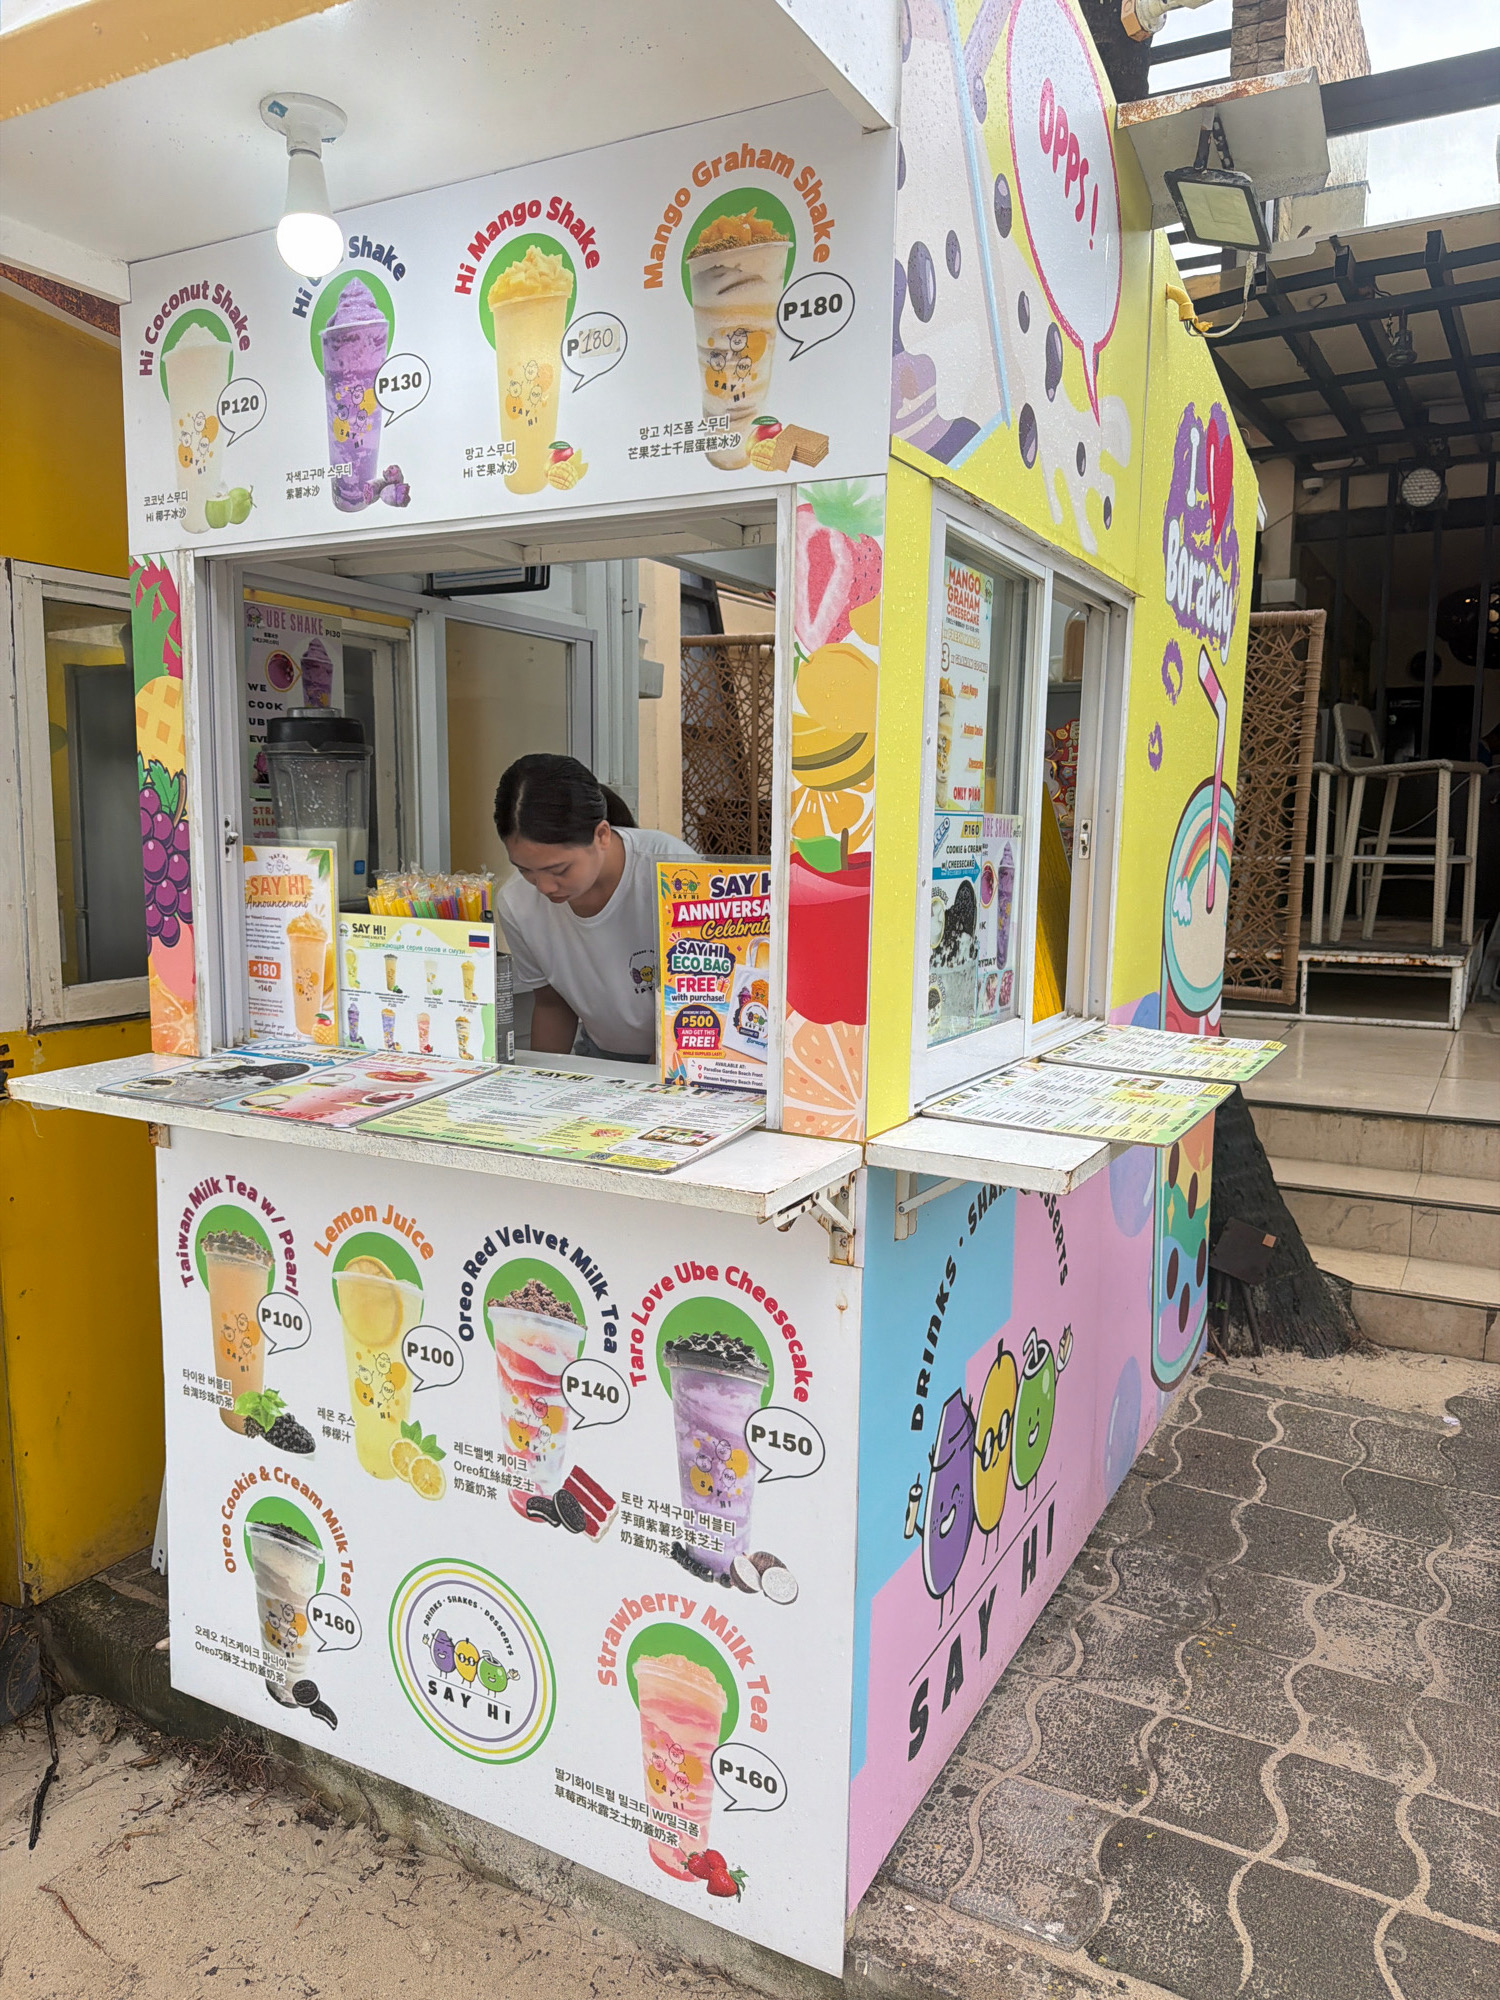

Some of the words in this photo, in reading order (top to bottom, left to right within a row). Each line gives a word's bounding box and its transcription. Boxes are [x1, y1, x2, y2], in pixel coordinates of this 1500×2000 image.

[1039, 77, 1098, 251] OPPS!
[644, 187, 691, 290] Mango
[692, 143, 795, 188] Graham
[793, 165, 835, 263] Shake
[454, 263, 477, 295] Hi
[467, 199, 542, 262] Mango
[546, 196, 600, 270] Shake
[292, 287, 313, 318] Hi
[348, 235, 406, 282] Shake
[145, 280, 210, 345] Coconut
[212, 283, 250, 351] Shake
[783, 293, 843, 322] P180
[139, 349, 154, 376] Hi
[378, 371, 422, 394] P130
[714, 380, 736, 392] SAY
[221, 395, 259, 416] P120
[733, 391, 746, 402] HI
[512, 406, 530, 417] SAY
[528, 417, 538, 426] HI
[639, 427, 660, 441] 망고
[697, 415, 730, 432] 스무디
[465, 447, 484, 461] 망고
[487, 442, 515, 457] 스무디
[286, 467, 325, 483] 자색고구마
[327, 463, 352, 478] 스무디
[463, 467, 473, 479] Hi
[476, 460, 518, 477] 芒果冰沙
[144, 493, 165, 507] 코코넛
[167, 490, 188, 504] 스무디
[146, 512, 154, 522] Hi
[948, 561, 981, 595] MANGO
[947, 585, 980, 613] GRAHAM
[1165, 518, 1233, 665] Boracay
[266, 609, 287, 631] UBE
[290, 613, 323, 637] SHAKE
[947, 603, 979, 626] CHEESECAKE
[247, 682, 267, 692] WE
[248, 700, 283, 711] COOK
[248, 718, 268, 726] UB
[963, 824, 980, 836] P160
[946, 845, 963, 854] COOKIE
[250, 876, 281, 896] SAY
[288, 875, 306, 896] HI
[711, 873, 757, 898] SAY
[245, 892, 309, 910] Announcement
[678, 899, 771, 922] ANNIVERSA
[352, 922, 370, 934] SAY
[373, 924, 386, 936] HI!
[678, 942, 706, 957] SAY
[709, 944, 724, 958] HI
[673, 955, 700, 970] ECO
[703, 958, 730, 972] BAG
[677, 977, 716, 993] FREE
[690, 994, 725, 1003] purchase!
[682, 1015, 714, 1028] P500
[681, 1036, 715, 1048] FREE!
[534, 1070, 565, 1079] SAY
[715, 1061, 738, 1069] AVAILABLE
[176, 1207, 195, 1288] Taiwan
[188, 1177, 223, 1209] Milk
[225, 1174, 258, 1203] Tea
[260, 1196, 286, 1223] w/
[278, 1229, 299, 1297] Pearl
[313, 1204, 377, 1257] Lemon
[382, 1204, 434, 1260] Juice
[495, 1224, 570, 1256] Velvet
[463, 1236, 498, 1280] Red
[569, 1247, 609, 1301] Milk
[674, 1260, 719, 1284] Ube
[459, 1281, 475, 1342] Oreo
[631, 1276, 676, 1326] Love
[262, 1307, 303, 1331] P100
[601, 1304, 620, 1354] Tea
[725, 1265, 813, 1403] Cheesecake
[911, 1253, 957, 1432] DRINKS
[407, 1341, 454, 1367] P100
[629, 1328, 648, 1388] Taro
[182, 1368, 206, 1385] 타이완
[207, 1375, 232, 1393] 버블티
[566, 1376, 619, 1404] P140
[317, 1406, 335, 1422] 레몬
[337, 1412, 356, 1427] 주스
[751, 1424, 813, 1456] P150
[259, 1465, 272, 1482] &
[497, 1453, 528, 1472] 케이크
[221, 1471, 258, 1520] Cookie
[273, 1466, 324, 1510] Cream
[453, 1477, 498, 1500] 奶蓋奶茶
[700, 1480, 723, 1497] SAY
[621, 1491, 644, 1509] 토란
[699, 1512, 735, 1537] 버블티
[720, 1500, 732, 1508] HI
[321, 1508, 348, 1554] Milk
[221, 1524, 237, 1574] Oreo
[340, 1559, 355, 1597] Tea
[312, 1607, 355, 1635] P160
[424, 1601, 442, 1626] DRINKS
[447, 1595, 478, 1609] SHAKES
[194, 1625, 219, 1642] 오레오
[220, 1635, 260, 1659] 치즈케이크
[907, 1585, 998, 1761] SAY
[1020, 1500, 1056, 1597] HI
[597, 1593, 697, 1687] Strawberry
[701, 1605, 755, 1671] Milk
[747, 1674, 771, 1733] Tea
[428, 1680, 471, 1708] SAY
[487, 1703, 510, 1725] HI
[719, 1758, 778, 1795] P160
[618, 1792, 649, 1817] 밀크티
